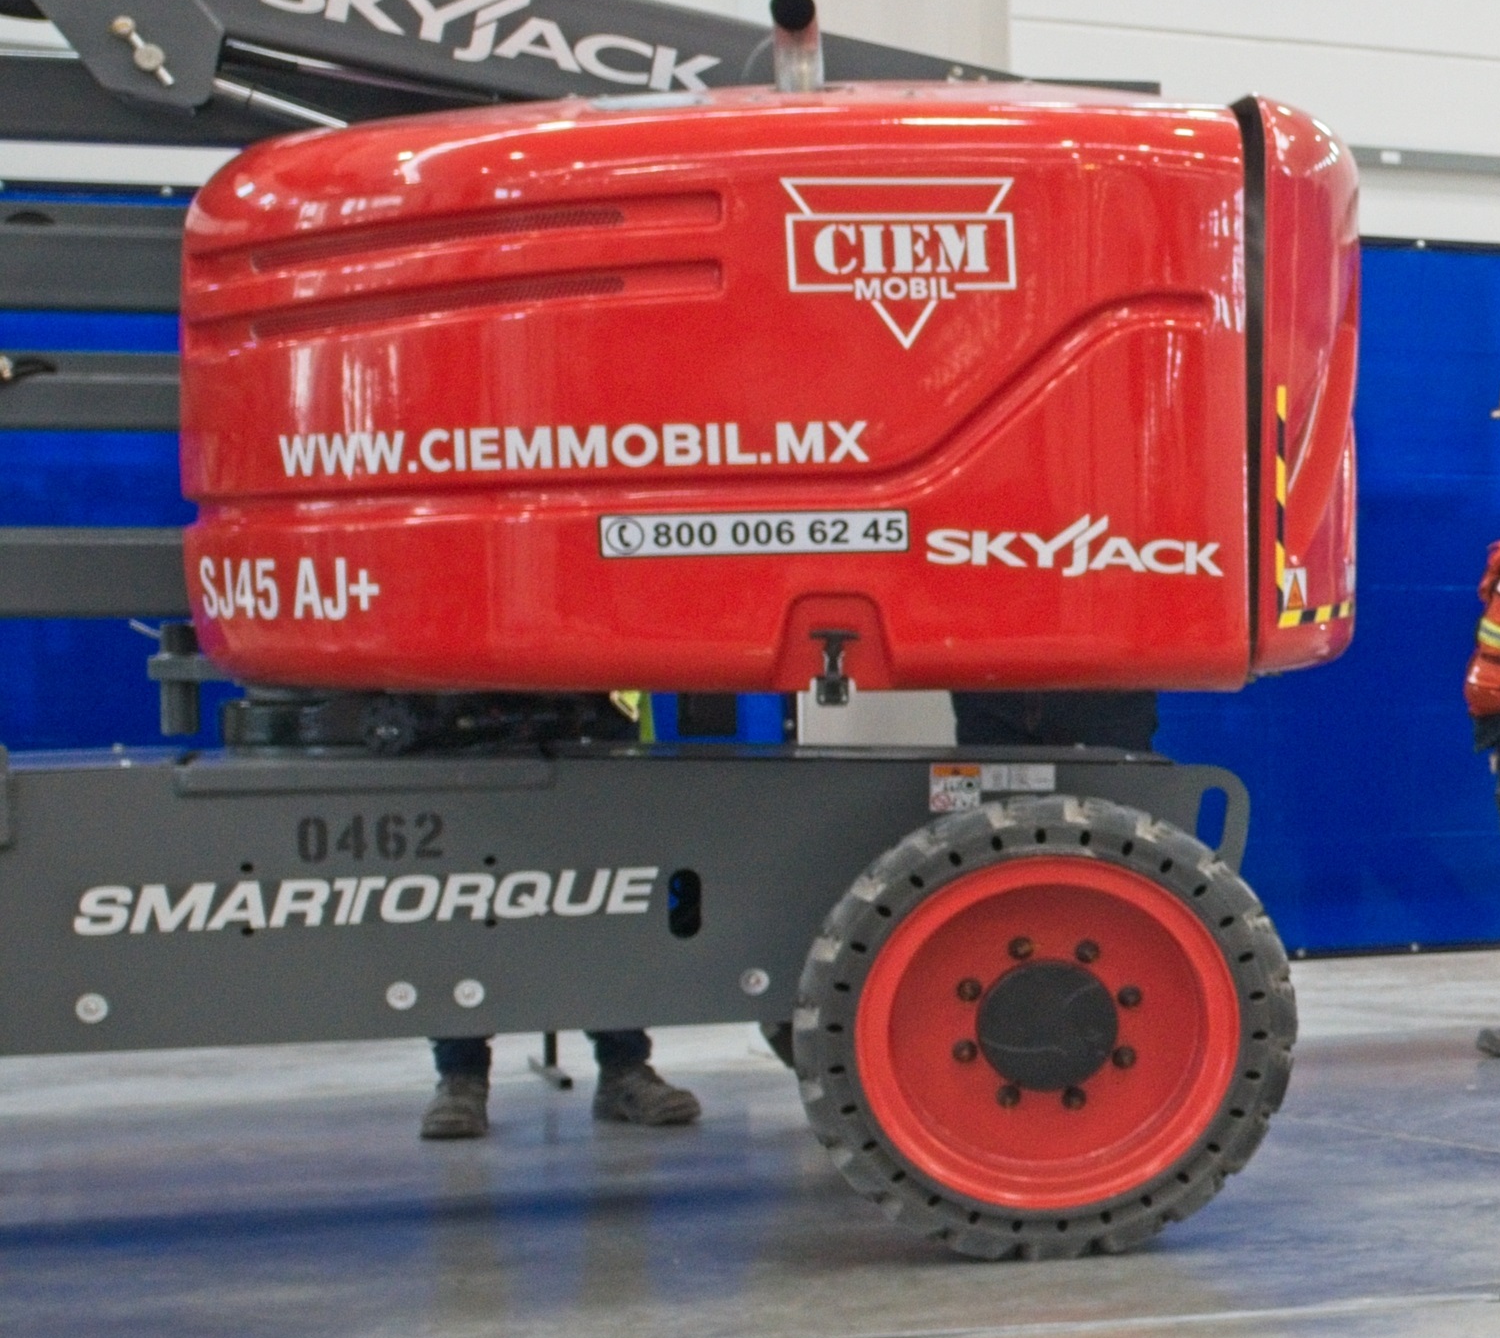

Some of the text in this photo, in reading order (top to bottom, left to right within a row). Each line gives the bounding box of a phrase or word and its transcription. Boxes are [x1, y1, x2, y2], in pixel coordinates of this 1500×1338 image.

[814, 224, 989, 274] CIEM
[854, 277, 956, 301] MOBIL
[279, 420, 870, 478] WWW.CIEMMOBIL.MX
[652, 517, 904, 548] 800 006 62 45
[925, 513, 1224, 577] SKYJACK
[200, 555, 380, 621] SJ45 AJ+
[299, 812, 444, 861] 0462
[73, 866, 659, 937] SMARTORQUE
